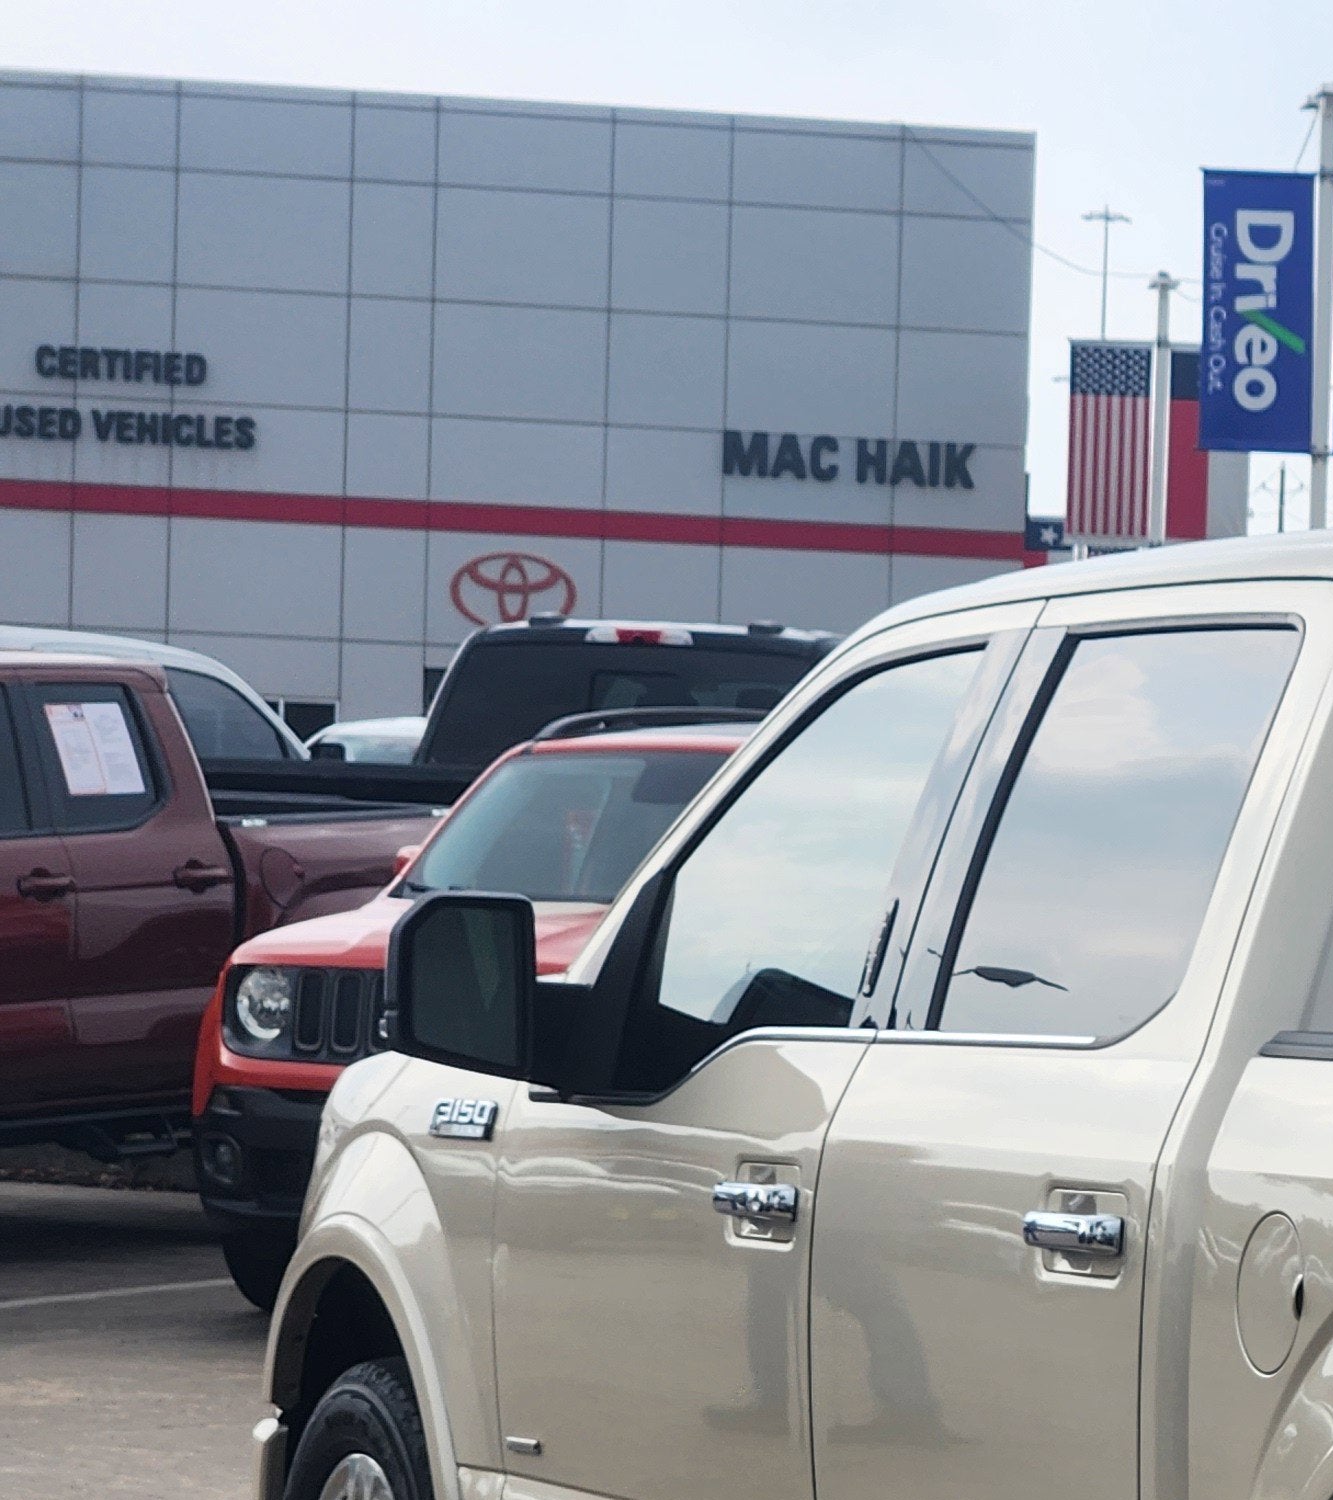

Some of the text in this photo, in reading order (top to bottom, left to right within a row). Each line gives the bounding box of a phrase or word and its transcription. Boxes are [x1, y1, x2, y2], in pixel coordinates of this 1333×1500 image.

[35, 345, 208, 387] CERTIFIED
[91, 408, 256, 449] VEHICLES
[722, 429, 977, 489] MAC HAIK
